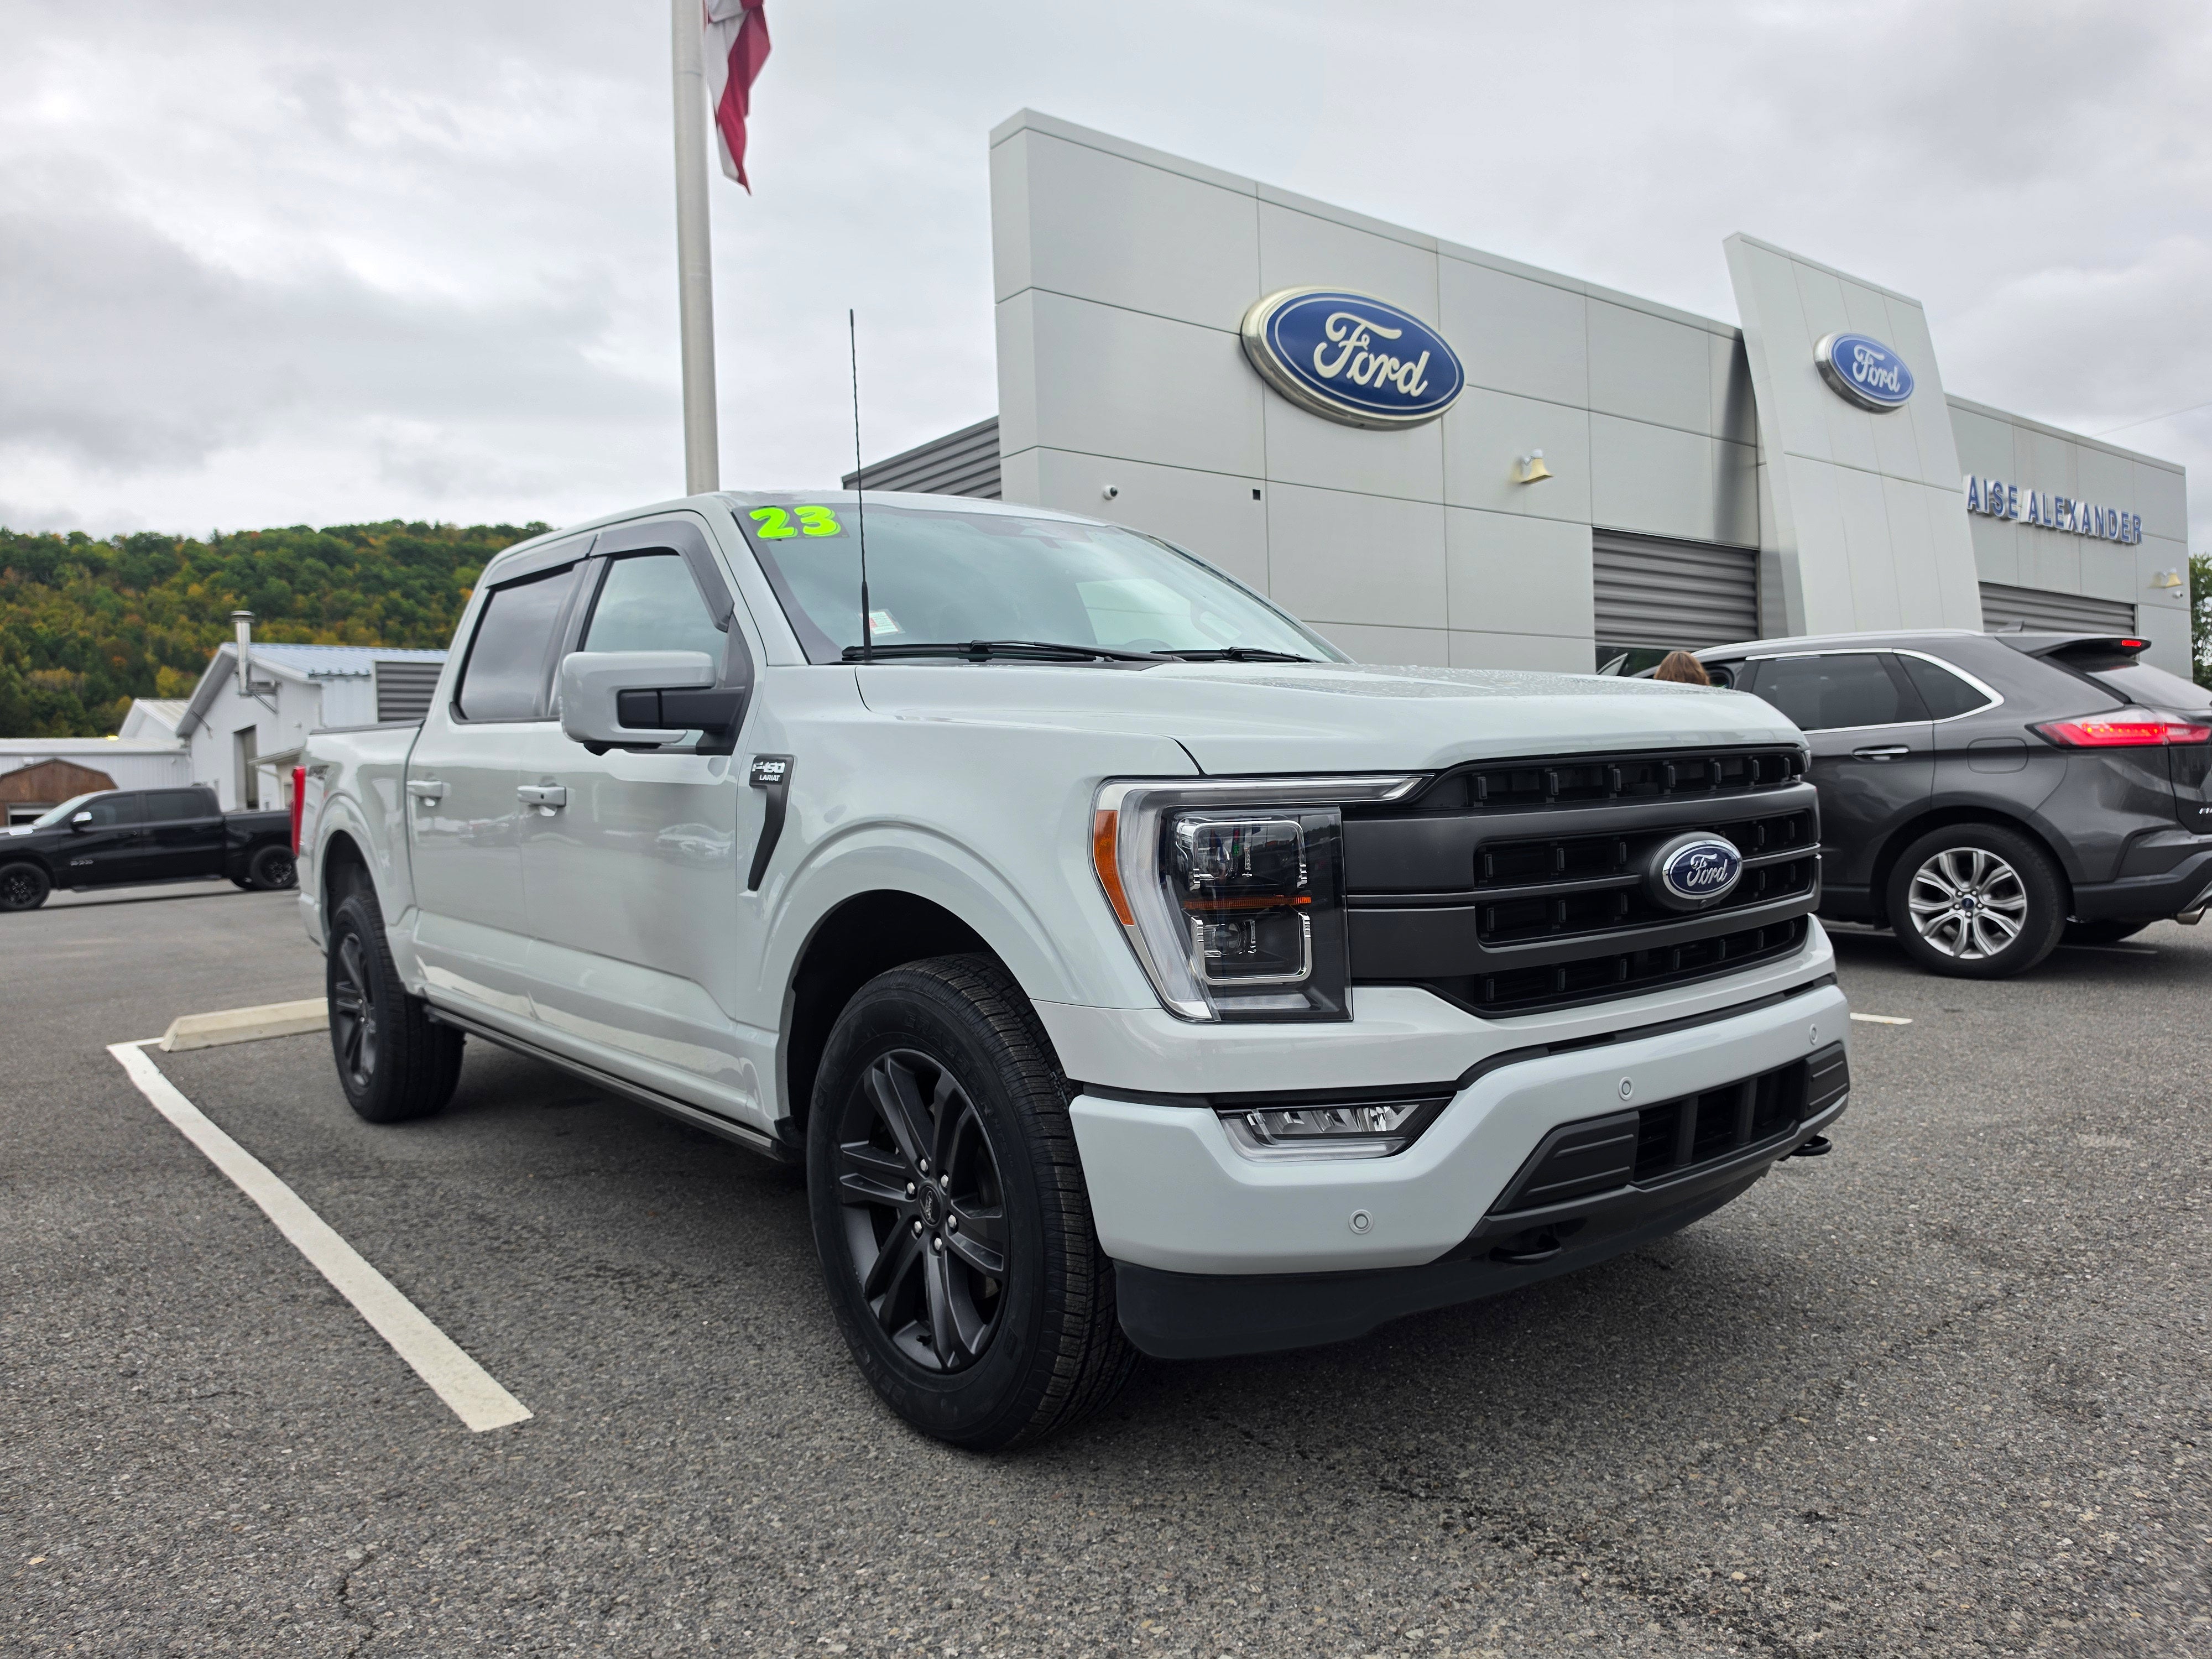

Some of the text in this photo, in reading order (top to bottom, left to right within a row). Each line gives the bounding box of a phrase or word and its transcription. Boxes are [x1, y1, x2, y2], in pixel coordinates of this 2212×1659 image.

[1313, 312, 1430, 397] Ford
[1853, 345, 1901, 393] Ford
[749, 505, 842, 539] 23
[2025, 490, 2143, 544] ALEXANDER
[1687, 853, 1728, 886] Ford
